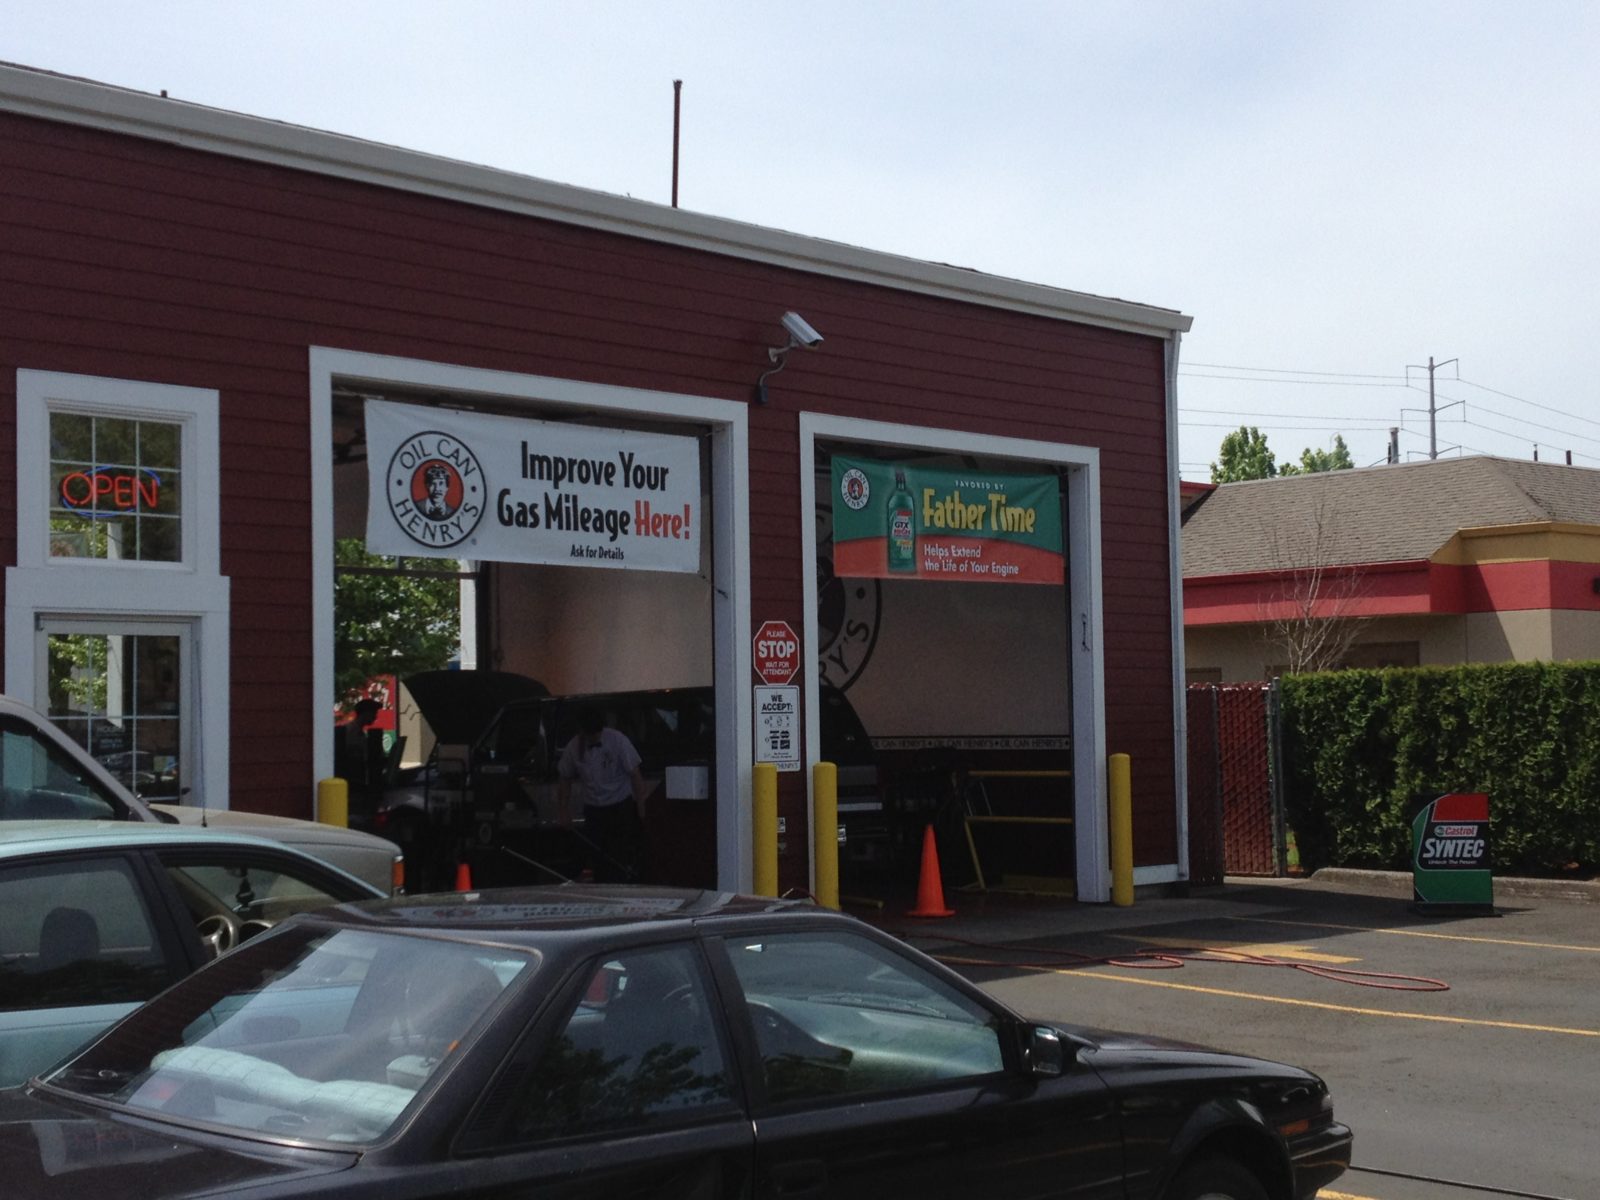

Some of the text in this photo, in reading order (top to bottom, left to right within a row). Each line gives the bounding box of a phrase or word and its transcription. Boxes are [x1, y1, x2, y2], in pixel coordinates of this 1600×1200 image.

[400, 438, 476, 477] OIL CAN
[521, 440, 669, 491] Improve Your
[62, 471, 158, 508] OPEN
[955, 480, 991, 489] FAVORED
[497, 488, 691, 542] Gas Mileage Here!
[922, 488, 1036, 533] Father Time
[395, 498, 480, 543] HENRY'S
[570, 544, 625, 561] Ask for Details
[924, 544, 949, 560] Helps
[951, 545, 981, 558] Extend
[925, 559, 1019, 577] the Life of Your Engine
[758, 640, 796, 658] STOP
[762, 703, 793, 712] ACCEPT:
[771, 695, 783, 703] WE
[1445, 827, 1475, 835] Castrol
[1423, 838, 1485, 858] SYNTEC
